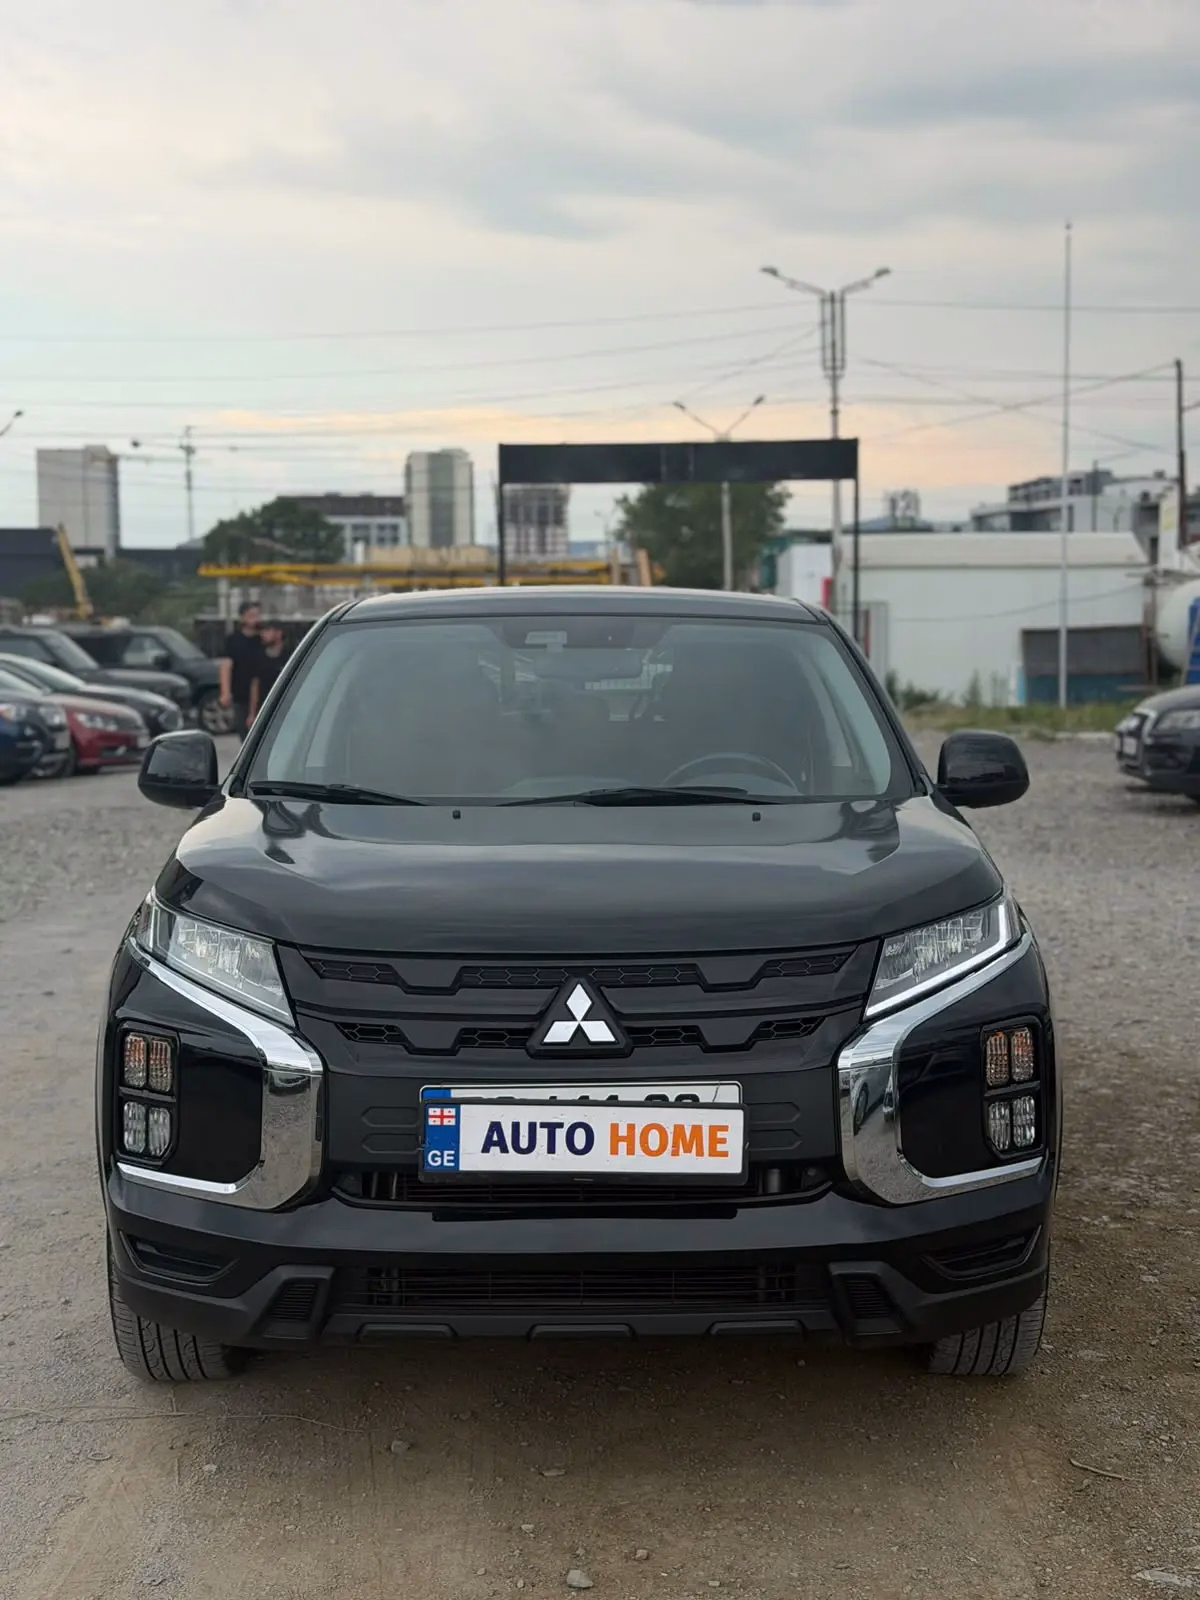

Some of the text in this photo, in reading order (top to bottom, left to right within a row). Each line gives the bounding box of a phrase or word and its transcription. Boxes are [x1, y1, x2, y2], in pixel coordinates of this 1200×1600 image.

[481, 1121, 730, 1158] AUTO HOME
[427, 1151, 455, 1167] GE
